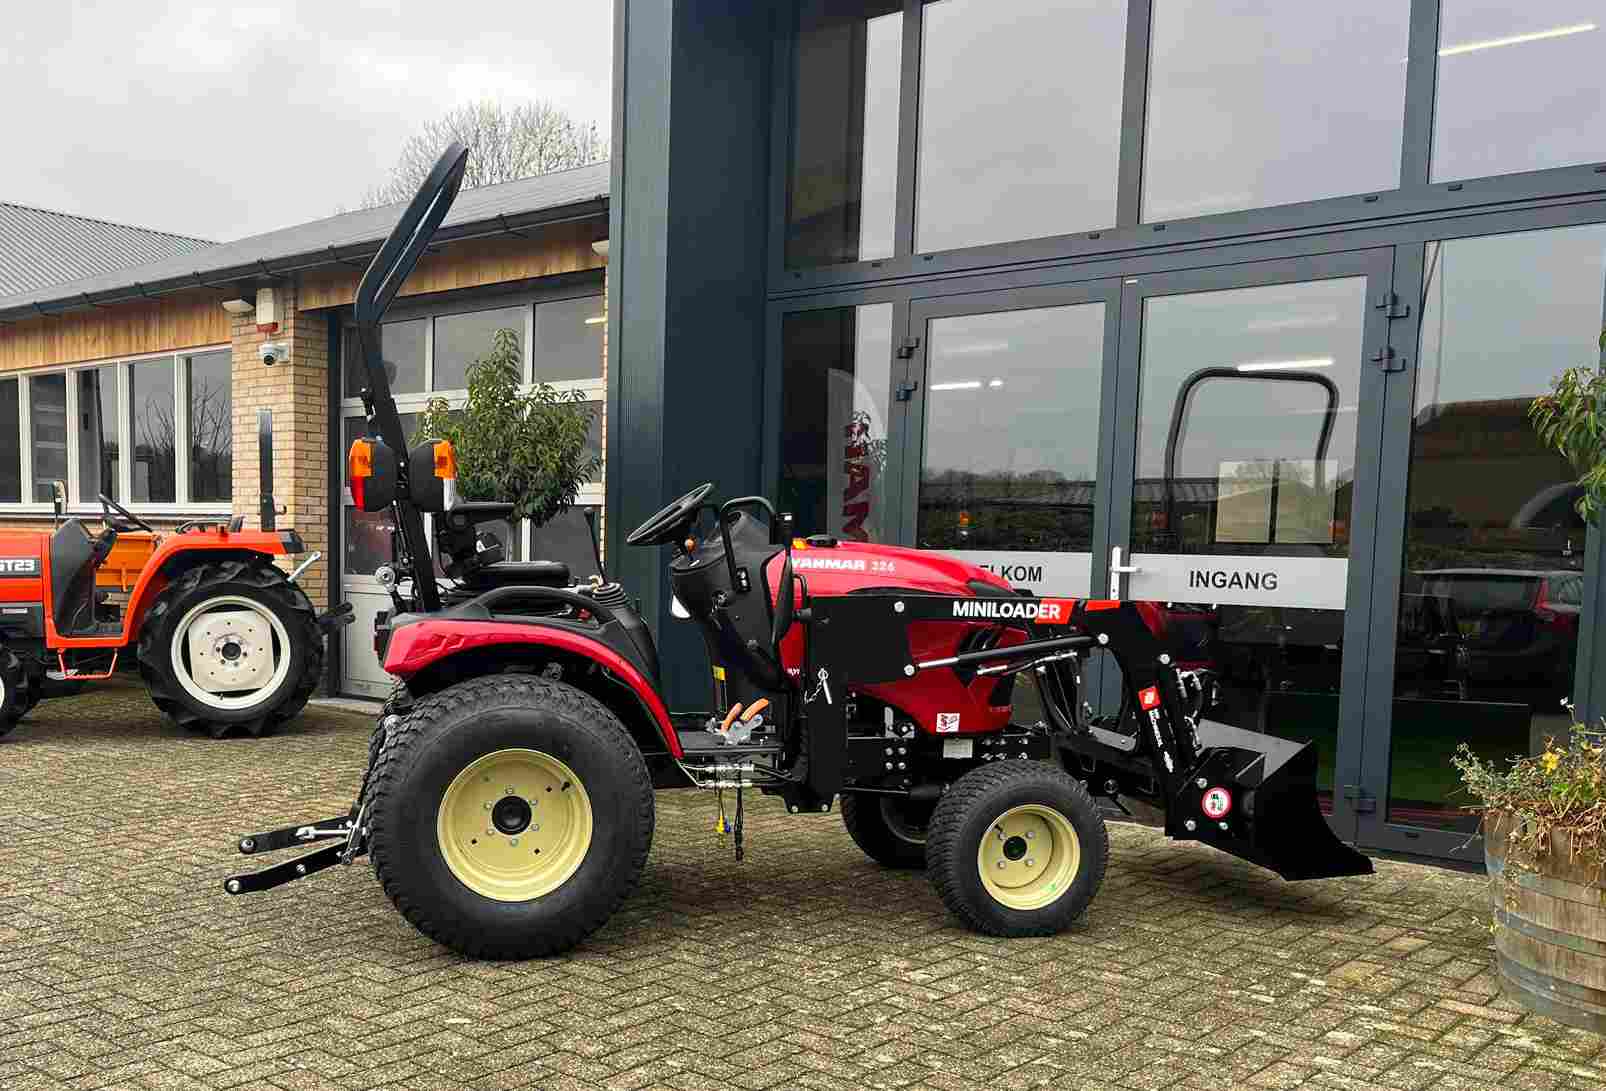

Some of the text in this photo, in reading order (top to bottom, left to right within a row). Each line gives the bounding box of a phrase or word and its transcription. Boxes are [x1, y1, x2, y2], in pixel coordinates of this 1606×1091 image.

[792, 558, 864, 571] YANMAR
[980, 565, 1042, 582] KOM
[1189, 570, 1278, 590] INGANG
[952, 601, 1061, 619] MINILOADER
